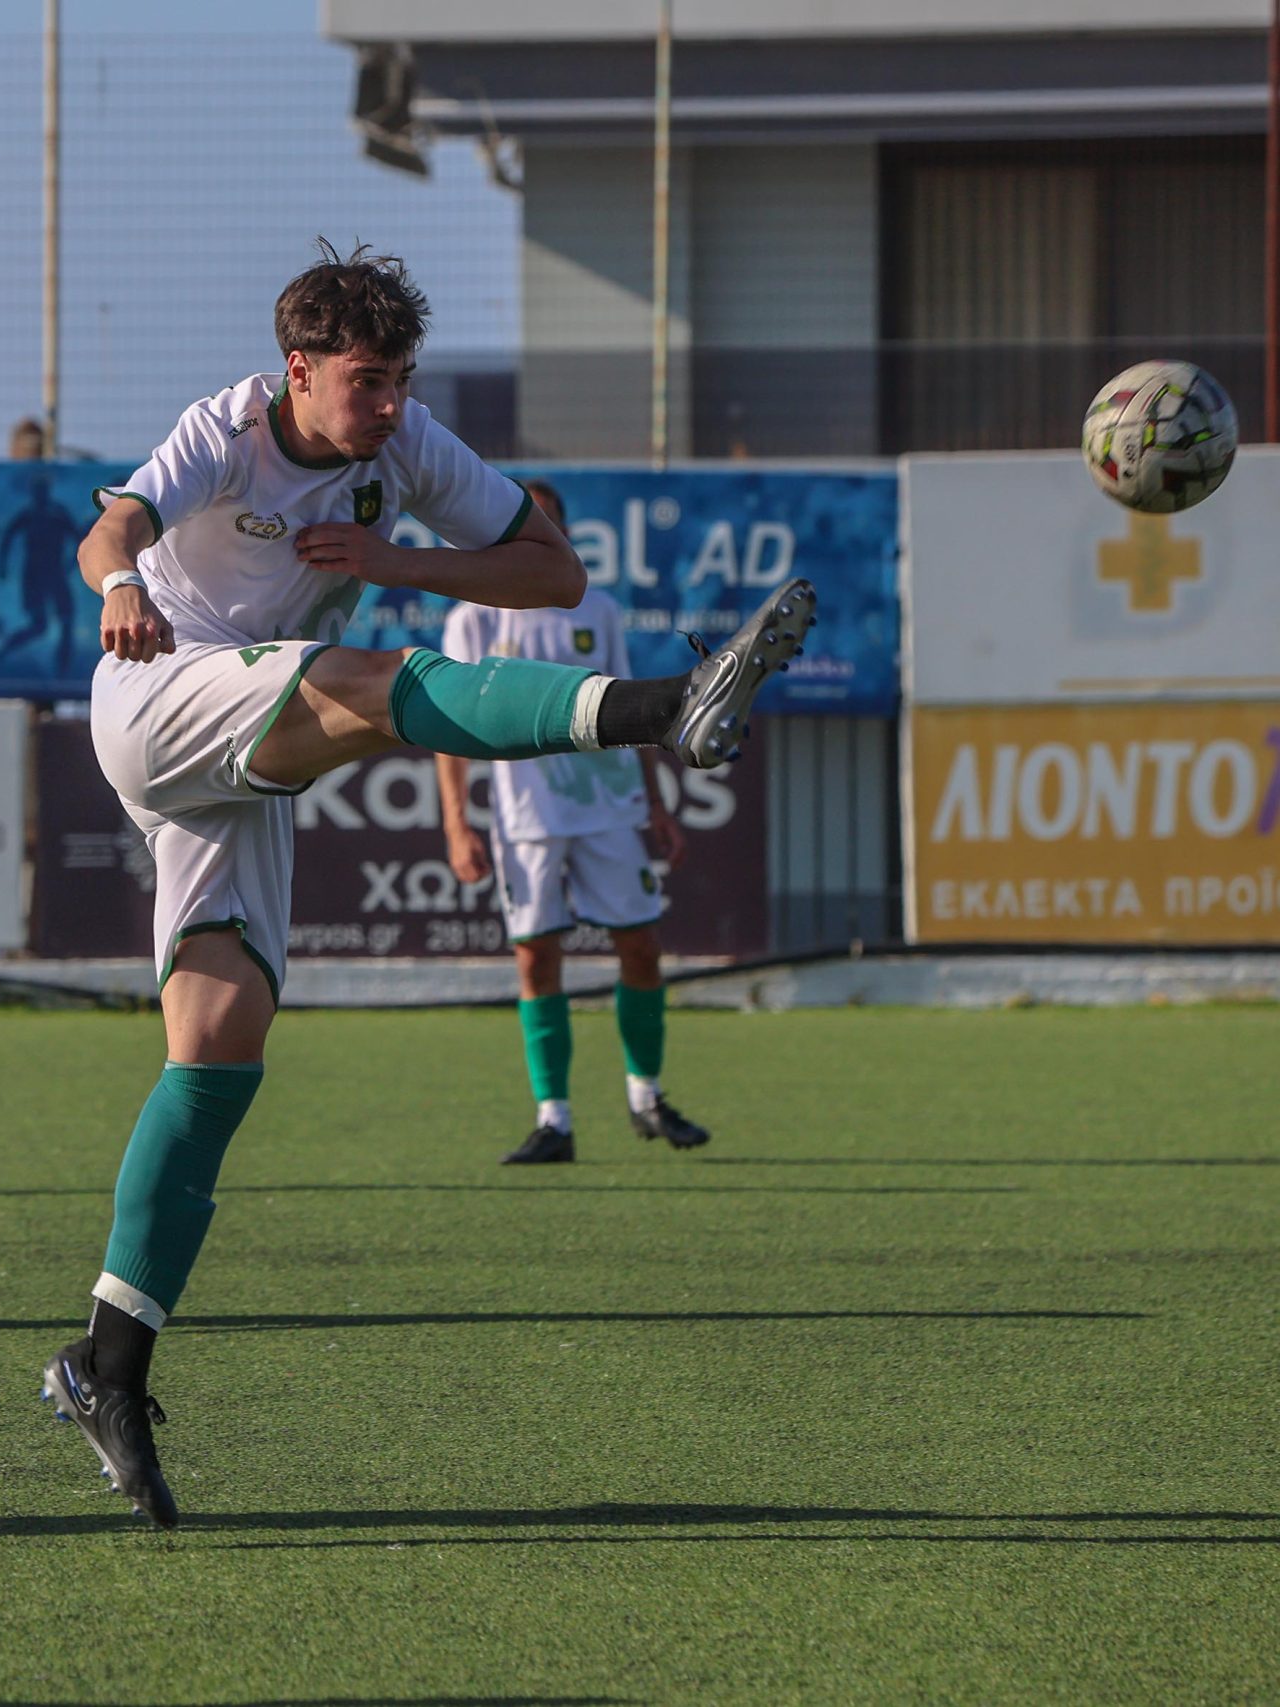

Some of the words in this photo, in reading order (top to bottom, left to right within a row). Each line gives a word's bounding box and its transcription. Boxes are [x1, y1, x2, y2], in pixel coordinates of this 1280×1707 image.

[688, 521, 797, 588] AD
[930, 878, 1142, 919] ΕΚΛΕΚΤΑ
[287, 924, 404, 954] arpos.gr
[424, 921, 501, 952] 2810
